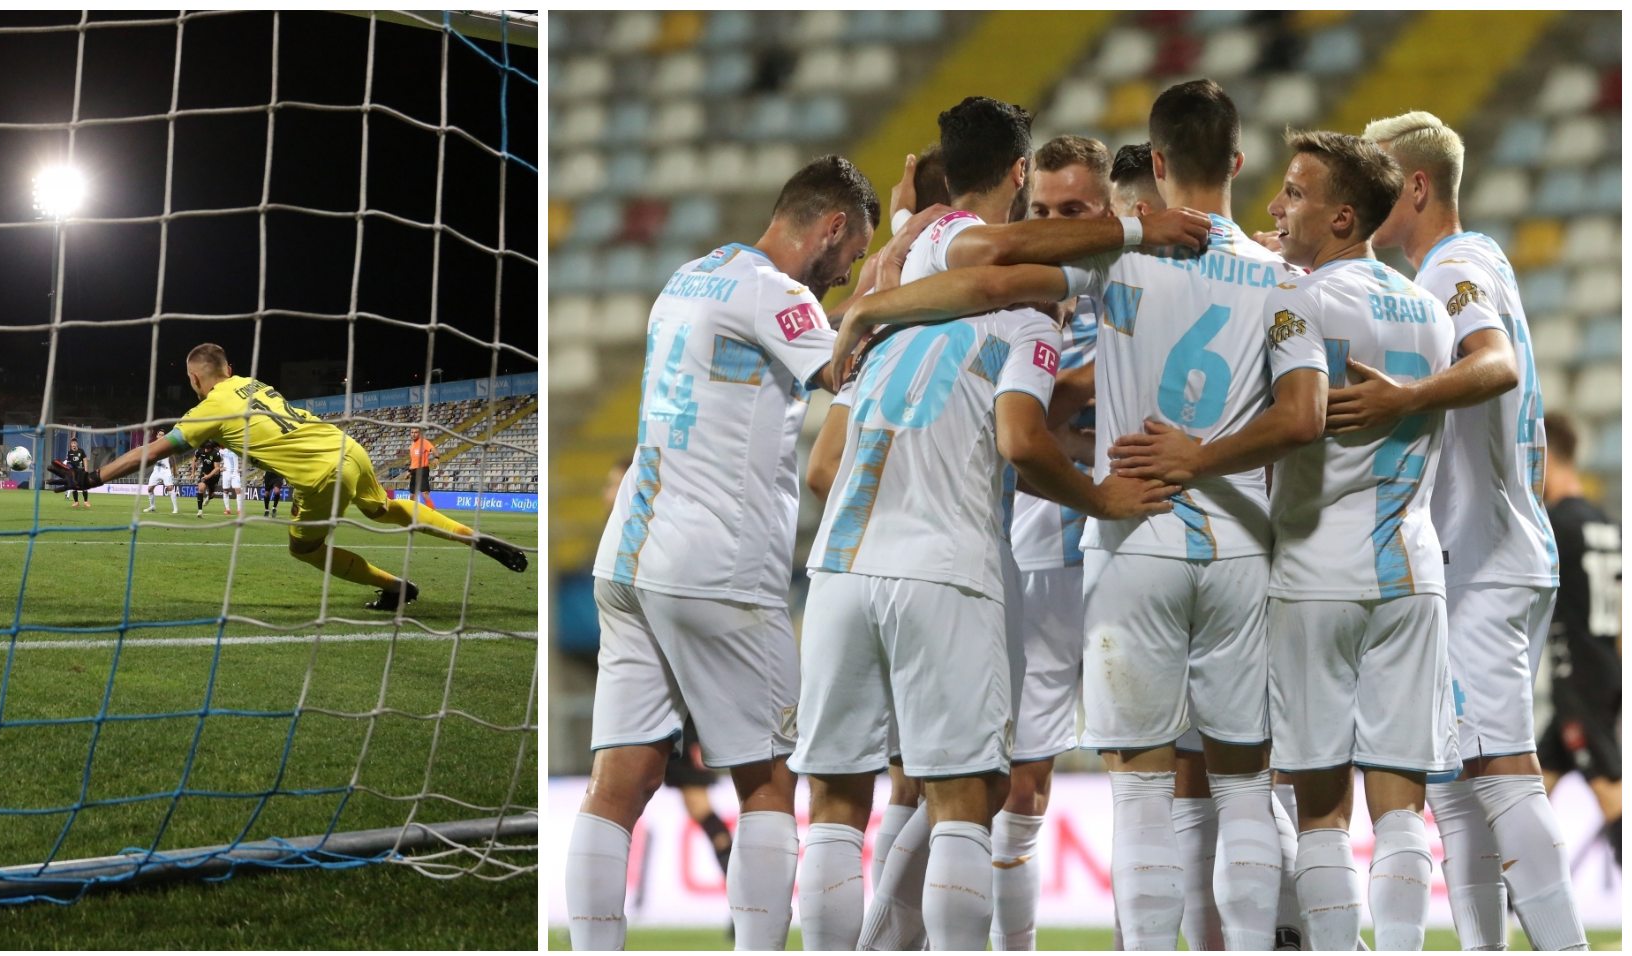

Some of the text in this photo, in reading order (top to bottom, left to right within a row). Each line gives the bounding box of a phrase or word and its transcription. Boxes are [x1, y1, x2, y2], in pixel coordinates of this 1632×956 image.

[638, 321, 698, 451] 14
[853, 321, 975, 429] 10
[1157, 304, 1232, 429] 6
[1373, 350, 1432, 479] 2
[457, 496, 471, 506] PIK
[474, 497, 502, 508] Rijeka
